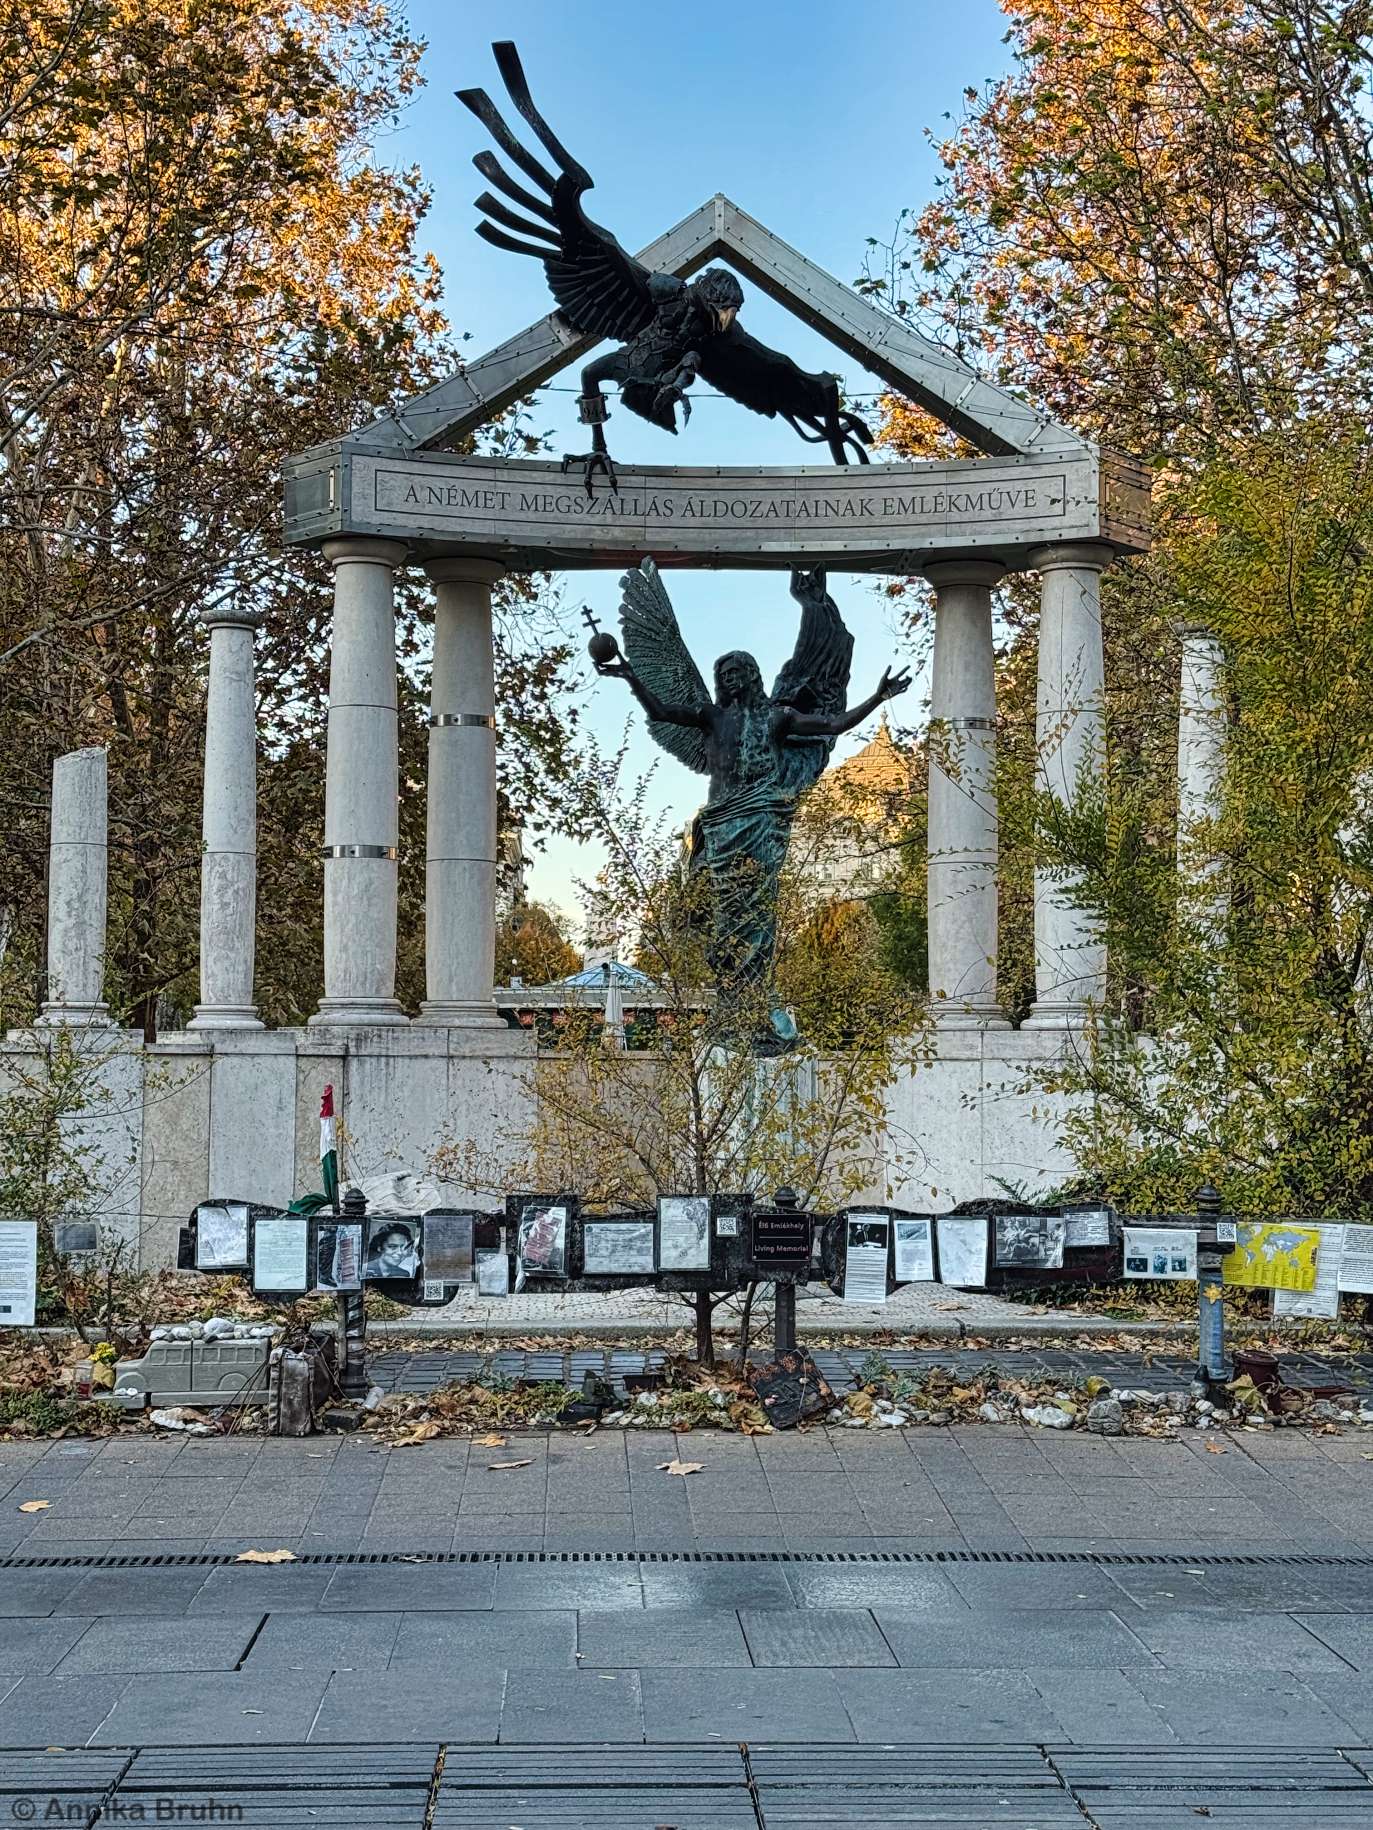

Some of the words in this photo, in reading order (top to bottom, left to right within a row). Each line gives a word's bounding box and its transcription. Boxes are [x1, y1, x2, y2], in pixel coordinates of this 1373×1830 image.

[405, 484, 420, 503] A
[426, 484, 511, 510] NÉMET
[519, 493, 674, 518] MEGSZÁLLÁS
[681, 496, 875, 518] ÁLDOZATAINAK
[881, 488, 1037, 516] EMLÉKMŰVE
[754, 1244, 775, 1254] Living
[776, 1243, 809, 1252] Memorial
